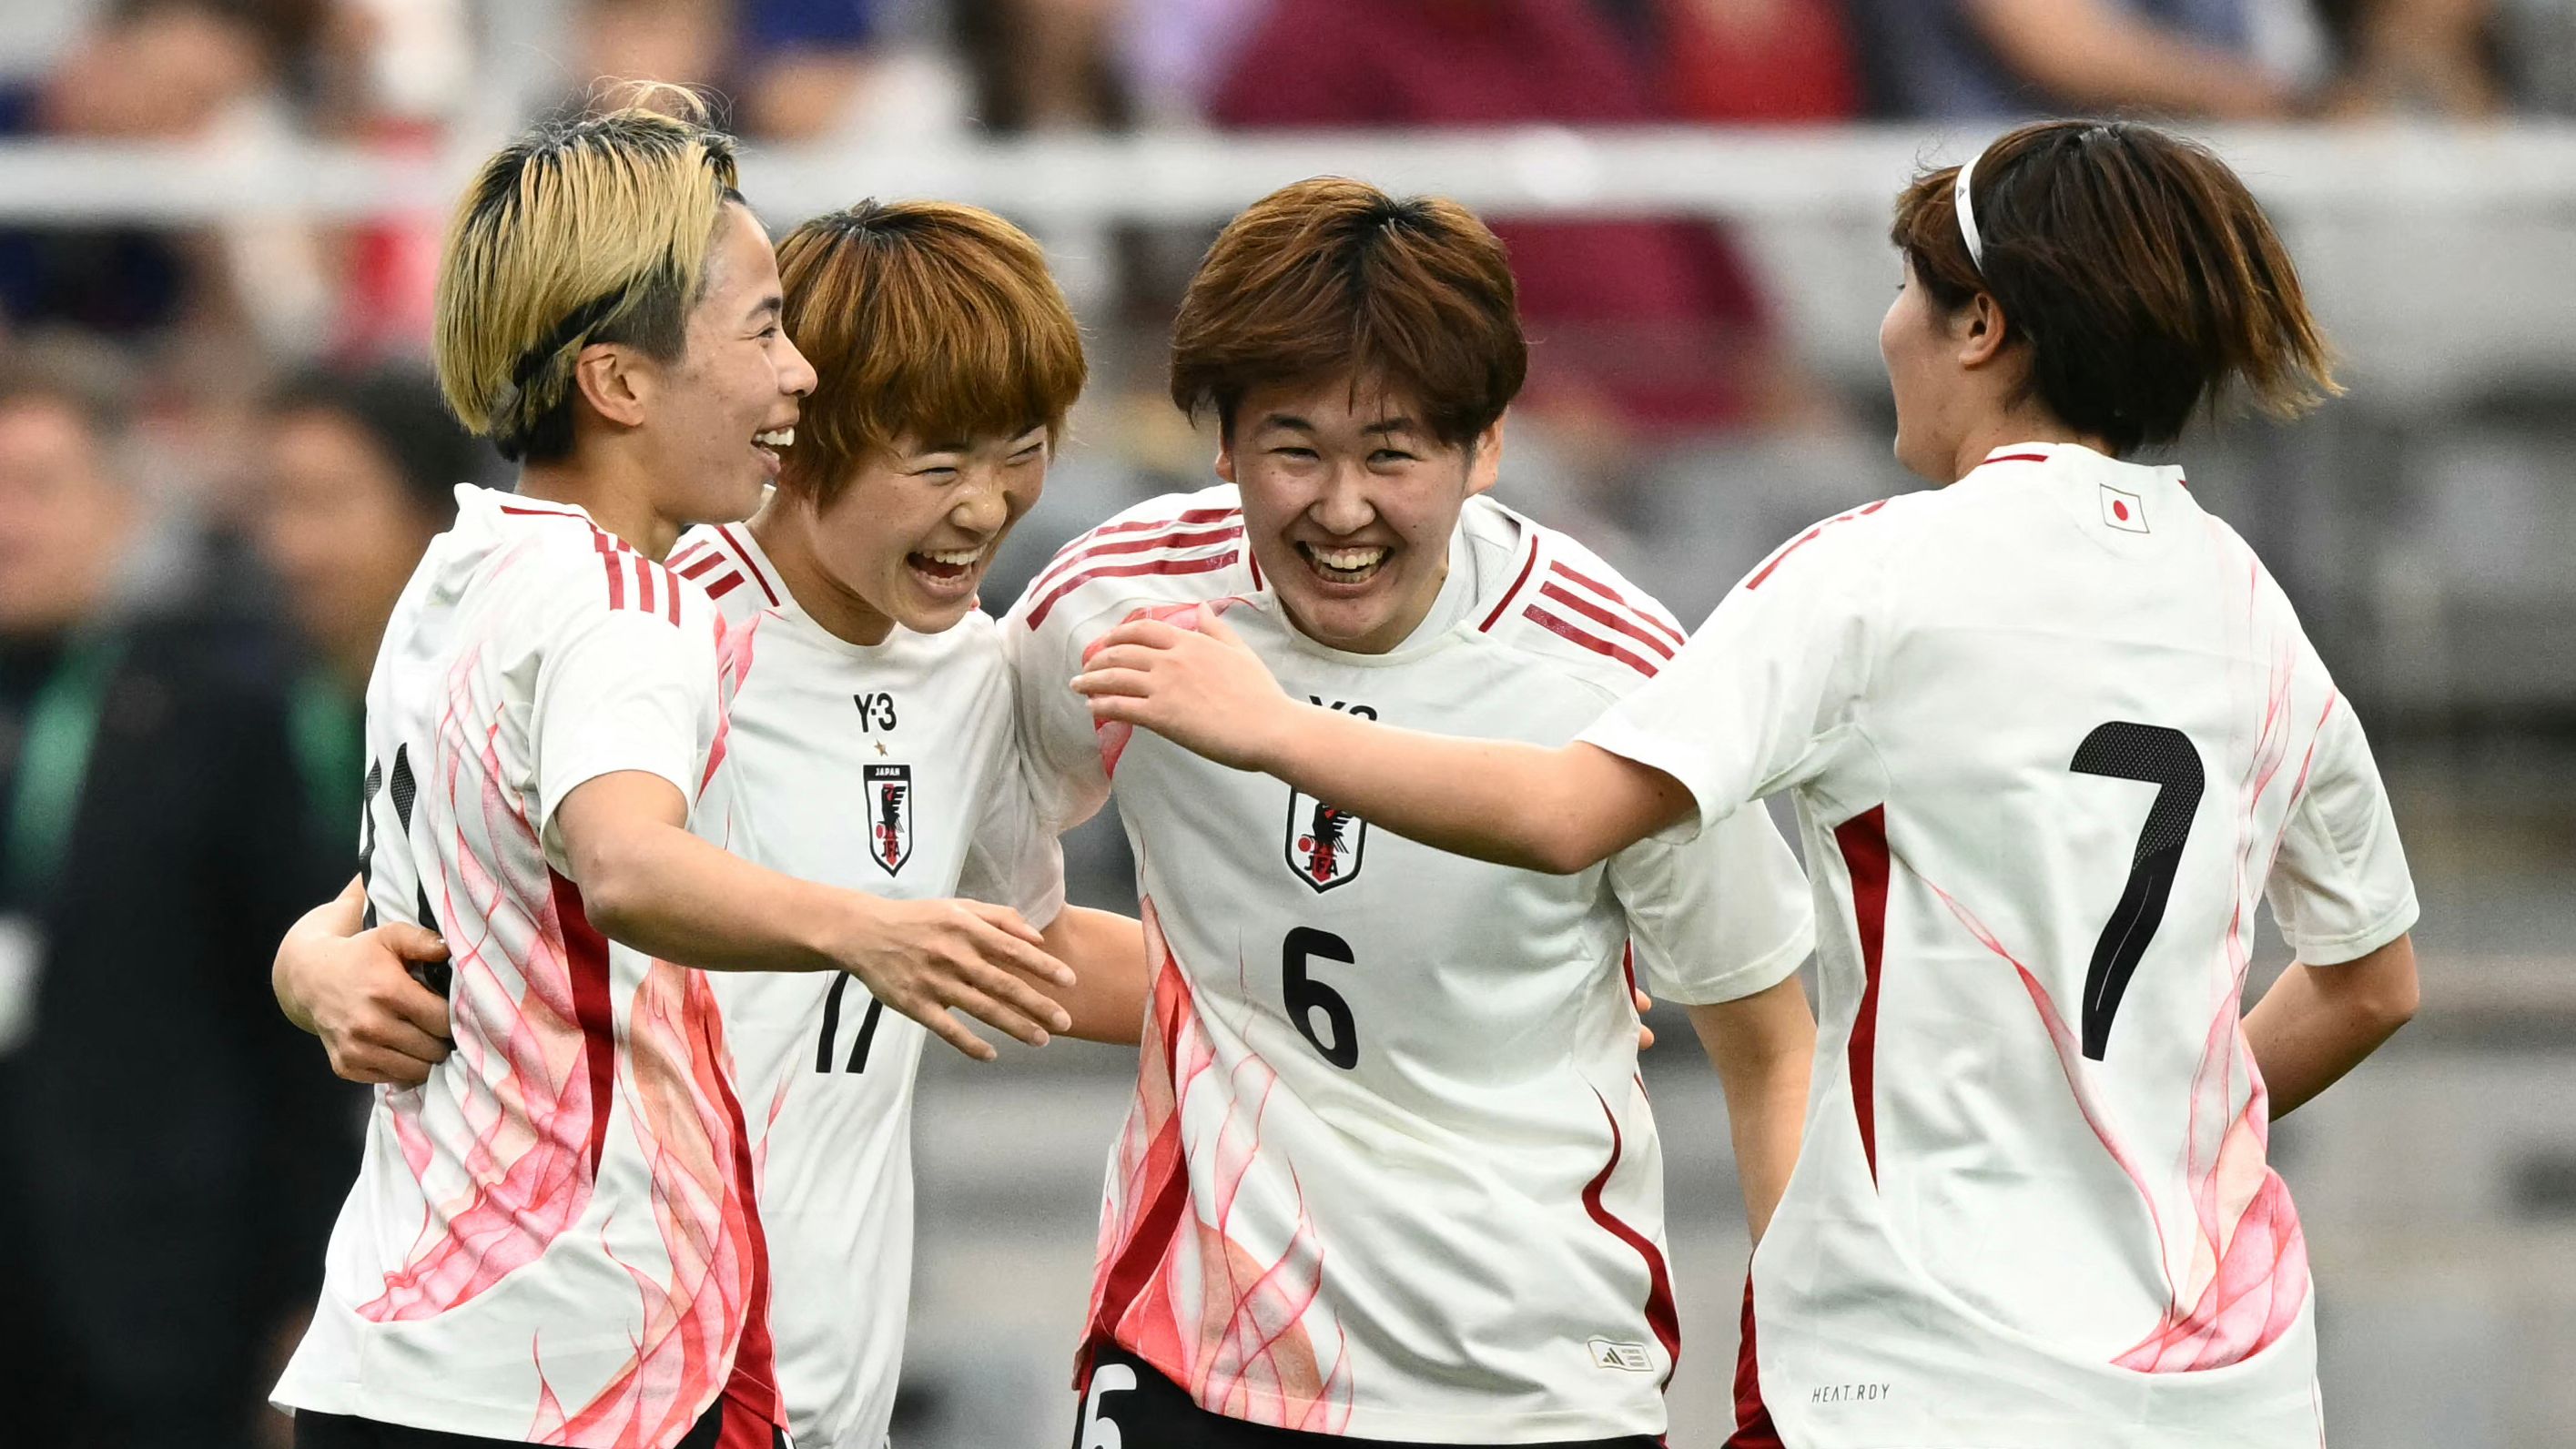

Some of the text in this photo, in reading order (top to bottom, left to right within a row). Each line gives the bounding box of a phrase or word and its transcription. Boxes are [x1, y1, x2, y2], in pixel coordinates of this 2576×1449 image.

[875, 766, 900, 776] JAPAN
[881, 841, 901, 857] JFA
[1303, 855, 1339, 877] JFA
[2069, 720, 2206, 1062] 7
[1283, 926, 1359, 1070] 6
